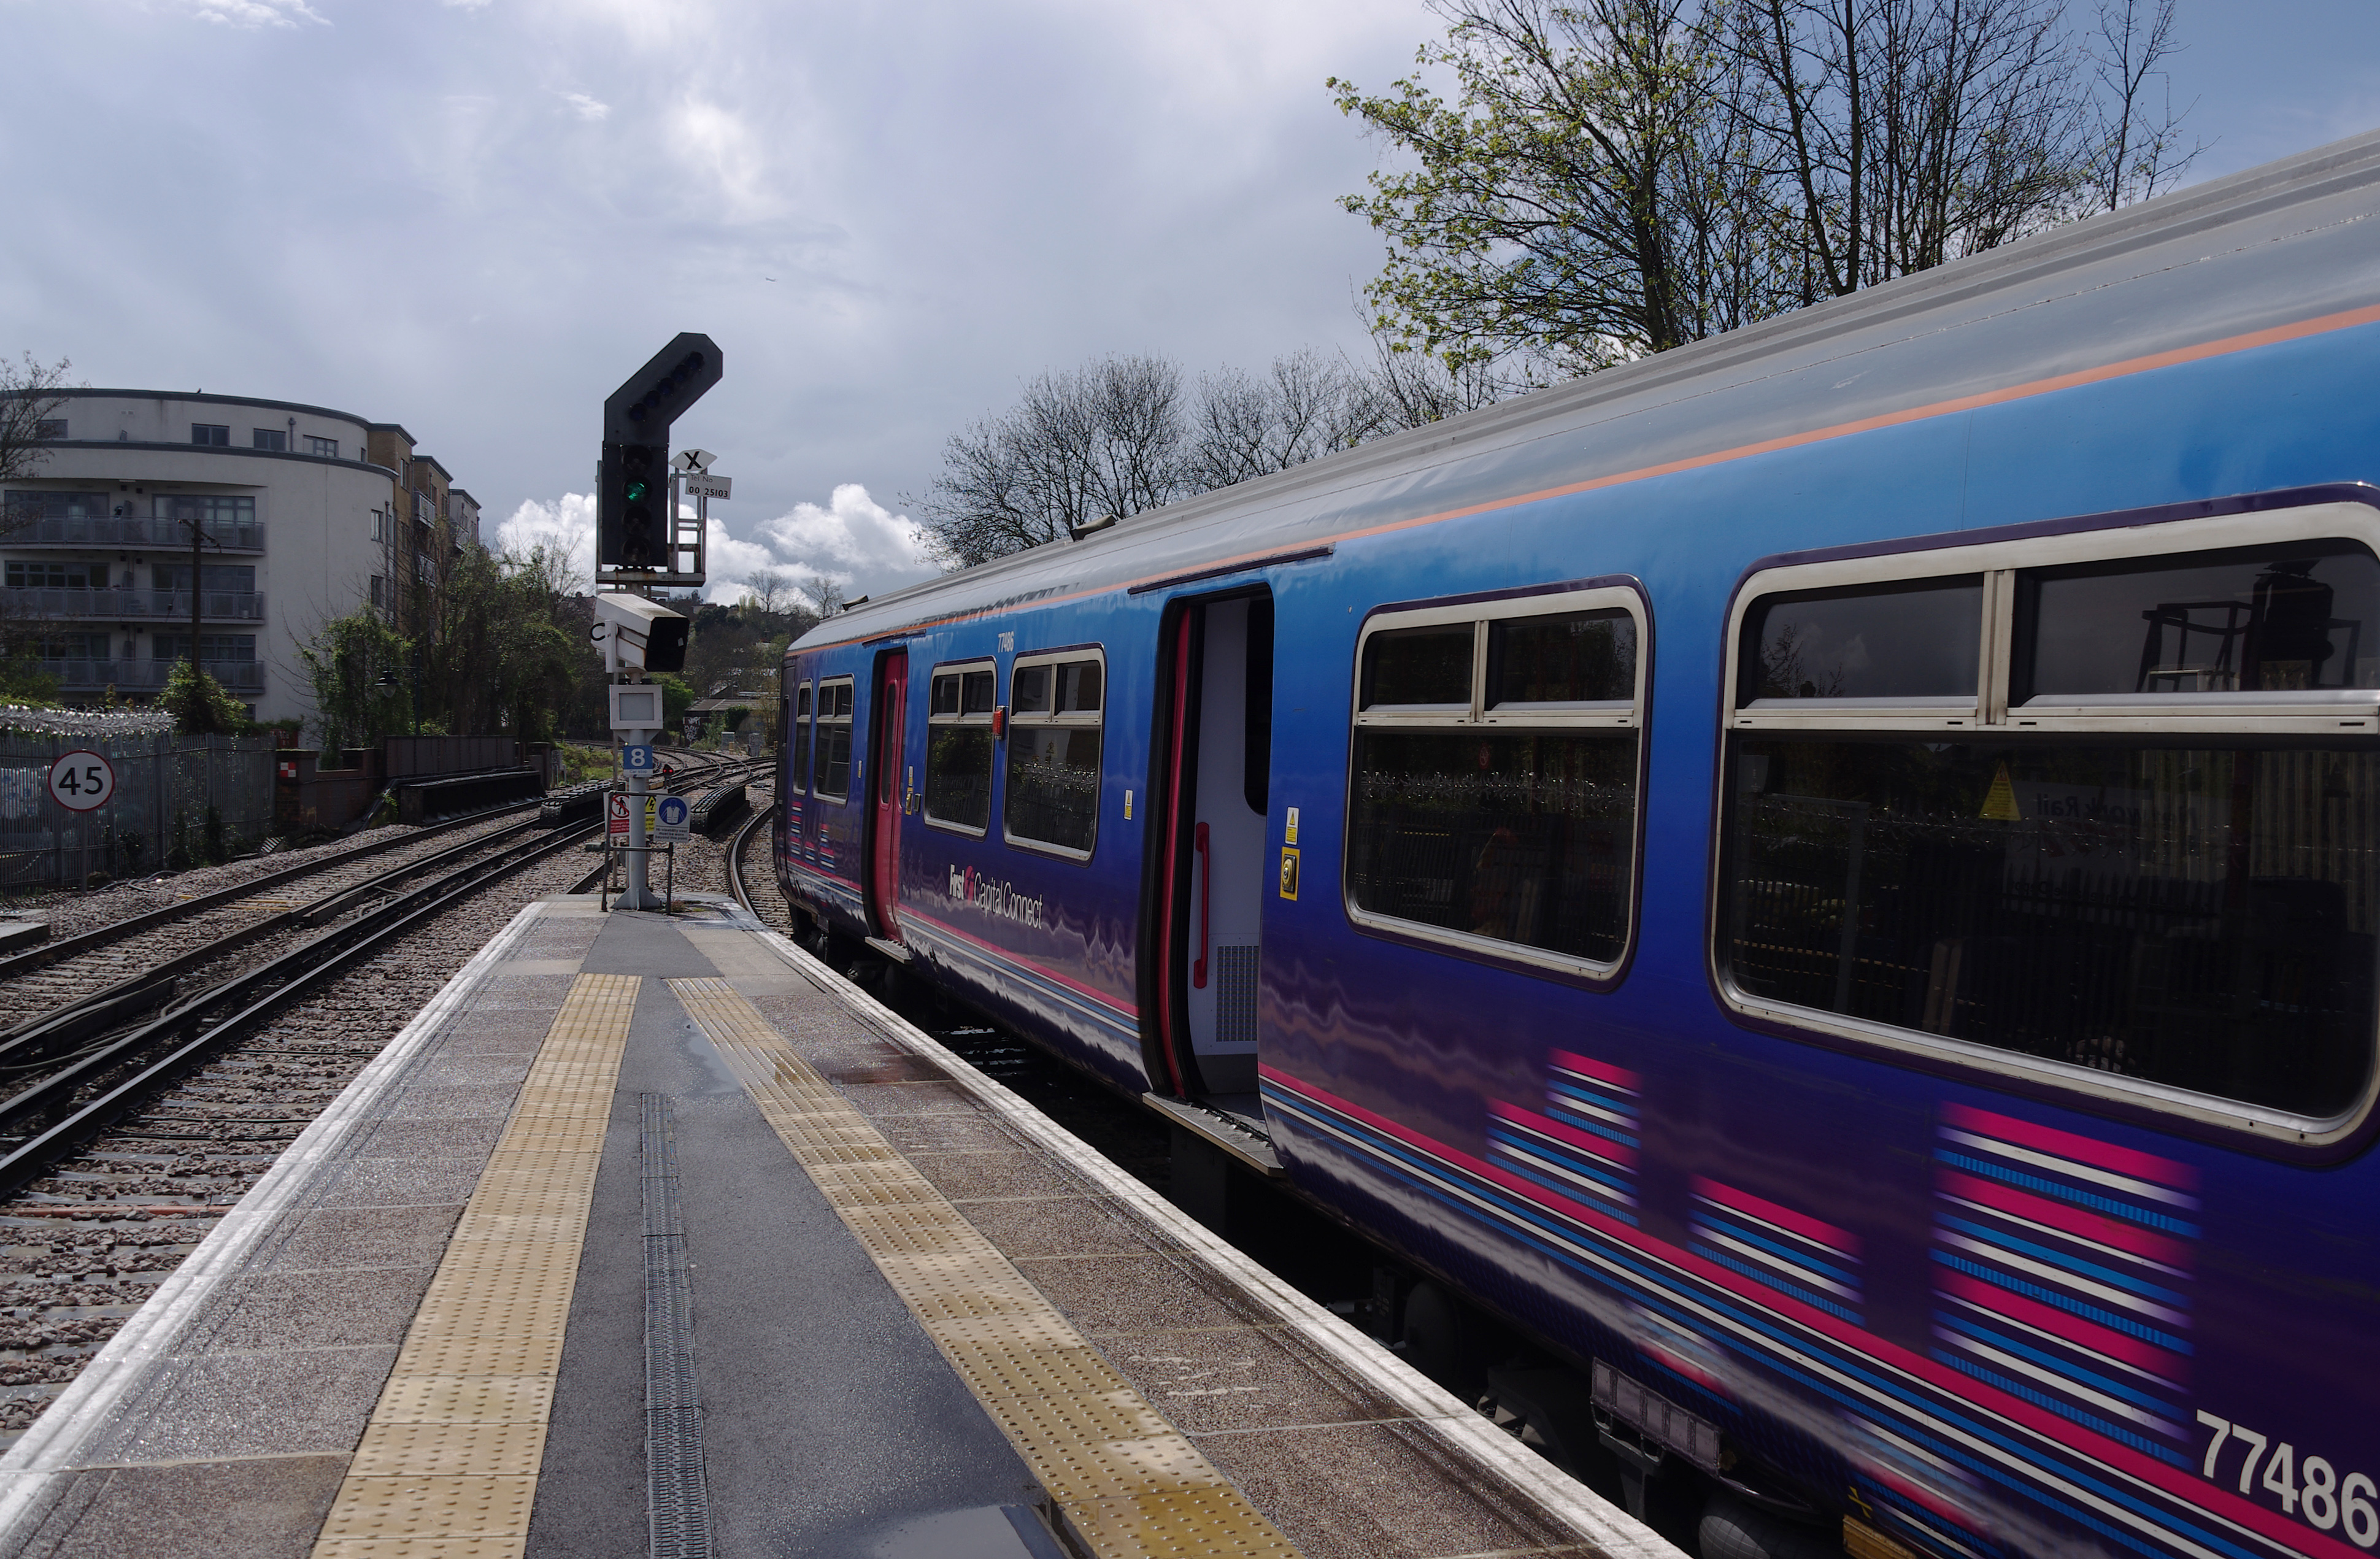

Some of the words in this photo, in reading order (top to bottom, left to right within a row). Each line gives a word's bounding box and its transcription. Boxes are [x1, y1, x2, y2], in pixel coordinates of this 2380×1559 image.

[684, 451, 703, 470] X
[690, 473, 699, 482] Tel
[704, 488, 728, 498] 25103
[998, 631, 1014, 653] 77486
[631, 748, 645, 767] 8
[59, 766, 104, 796] 45
[949, 864, 965, 900] First
[974, 872, 1003, 918] Capital
[1003, 882, 1043, 930] Connect
[2197, 1409, 2379, 1548] 77486
